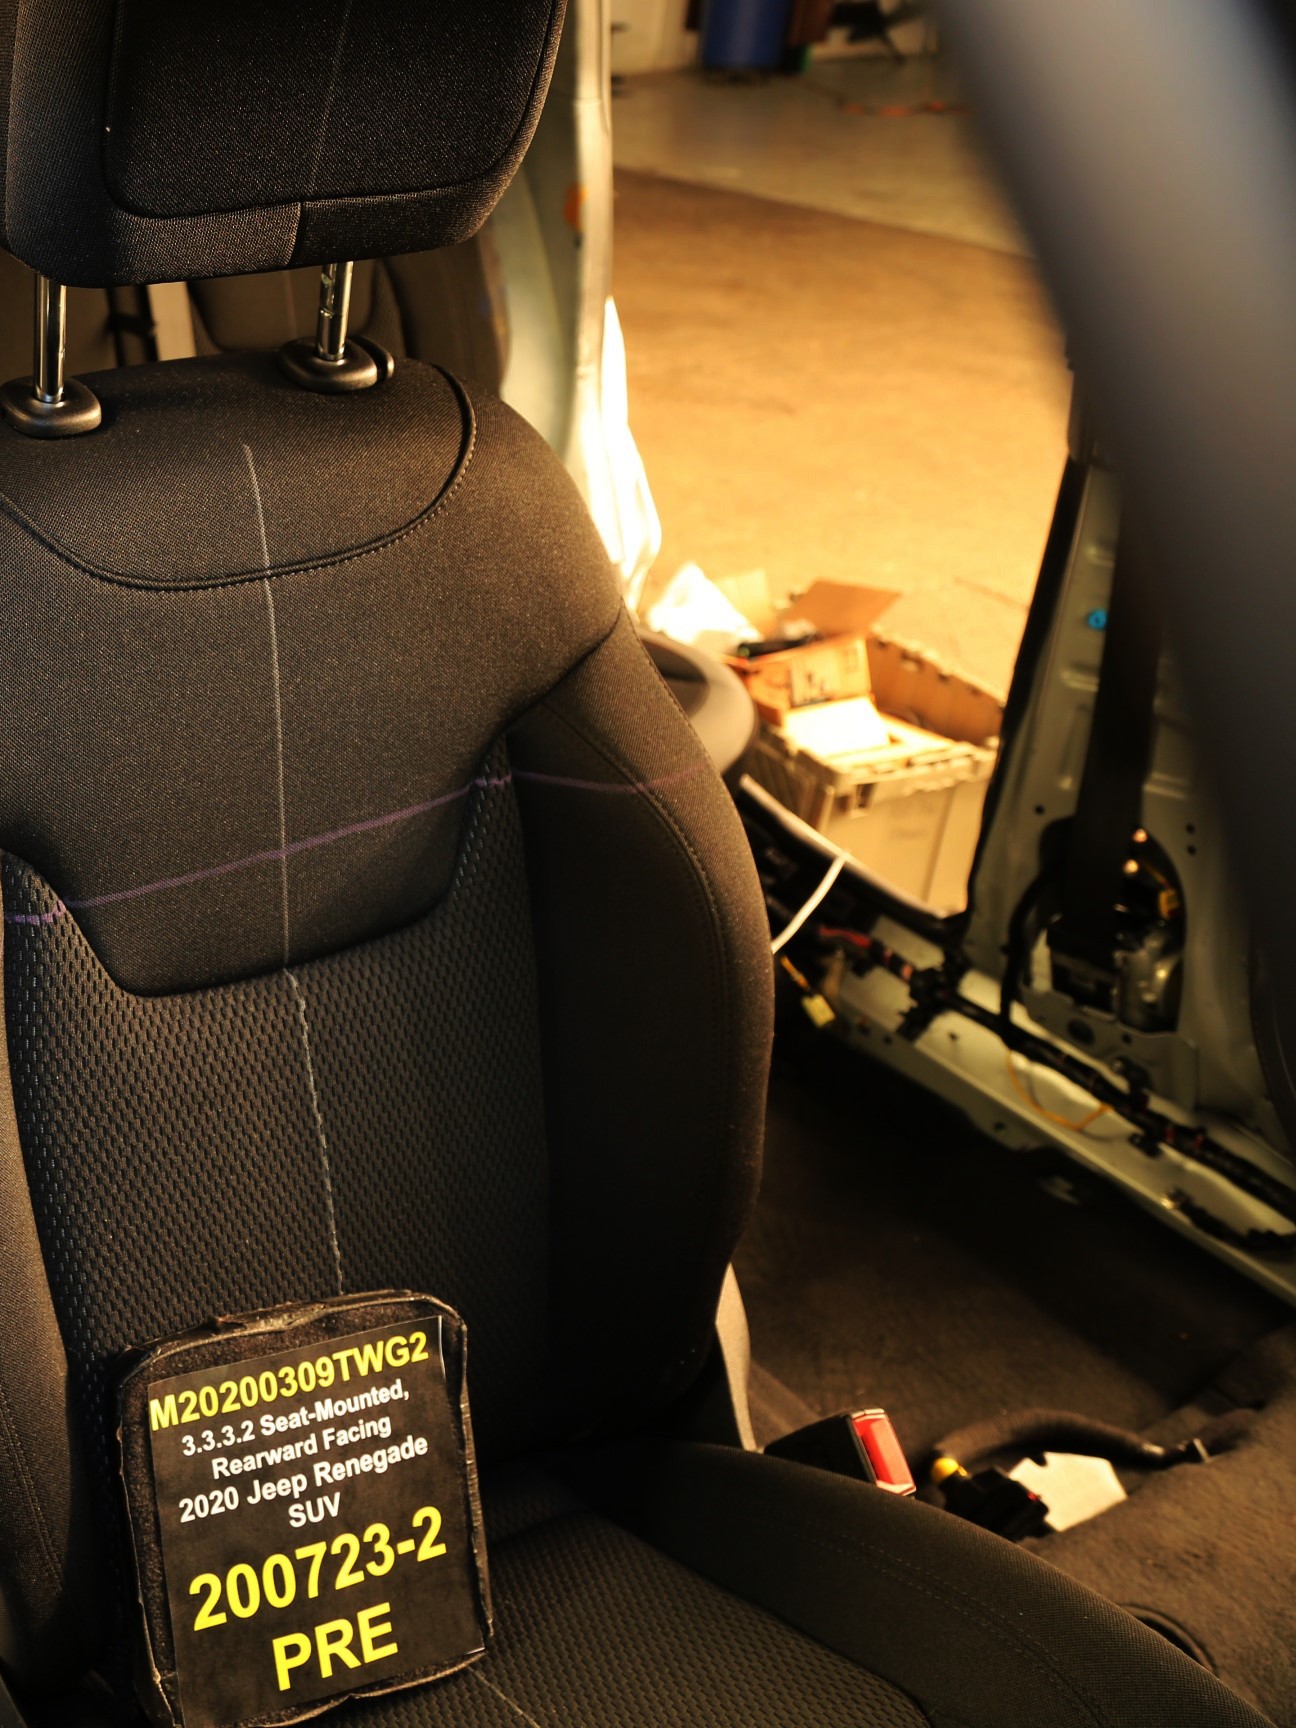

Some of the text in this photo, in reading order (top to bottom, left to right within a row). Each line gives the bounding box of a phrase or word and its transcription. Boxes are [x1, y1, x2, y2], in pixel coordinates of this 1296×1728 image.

[149, 1332, 428, 1431] M20200309TWG2
[181, 1379, 410, 1457] 3.3.3.2 Seat-Mounted,
[178, 1434, 428, 1523] 2020 Jeep Renegade
[211, 1415, 392, 1479] Rearward Facing
[287, 1493, 341, 1528] SUV
[188, 1506, 446, 1632] 200723-2
[271, 1602, 399, 1692] PRE
